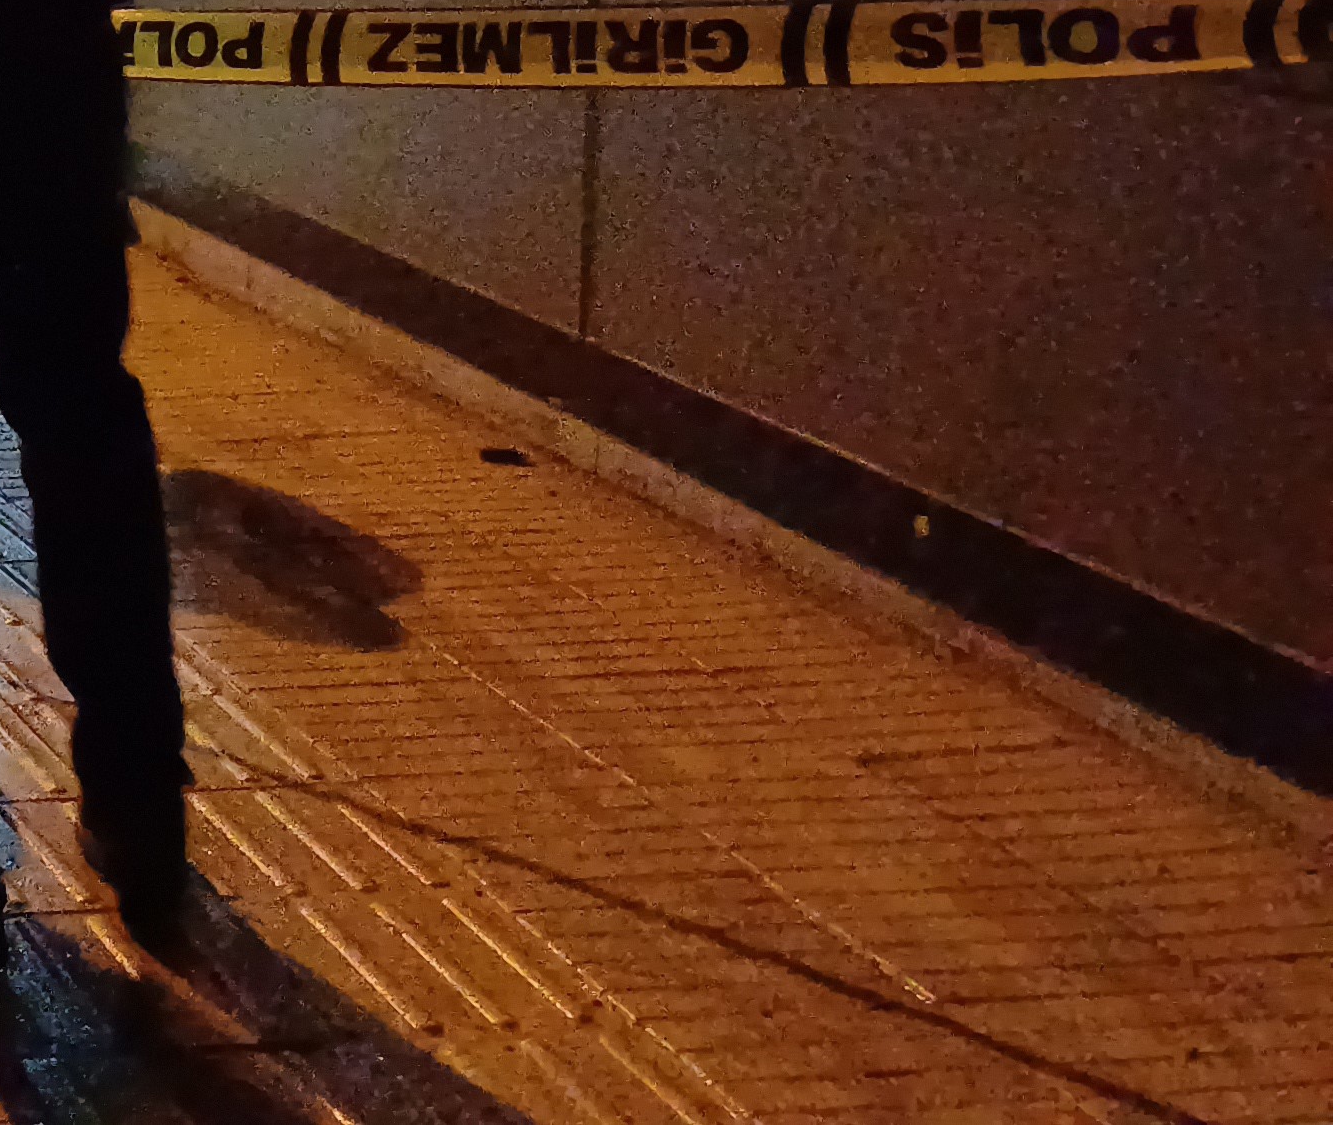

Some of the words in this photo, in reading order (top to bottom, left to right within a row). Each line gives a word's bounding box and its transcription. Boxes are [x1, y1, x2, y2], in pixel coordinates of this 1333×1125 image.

[113, 20, 266, 70] POLİ
[366, 17, 750, 75] GİRİLMEZ
[893, 4, 1201, 69] POLİS
